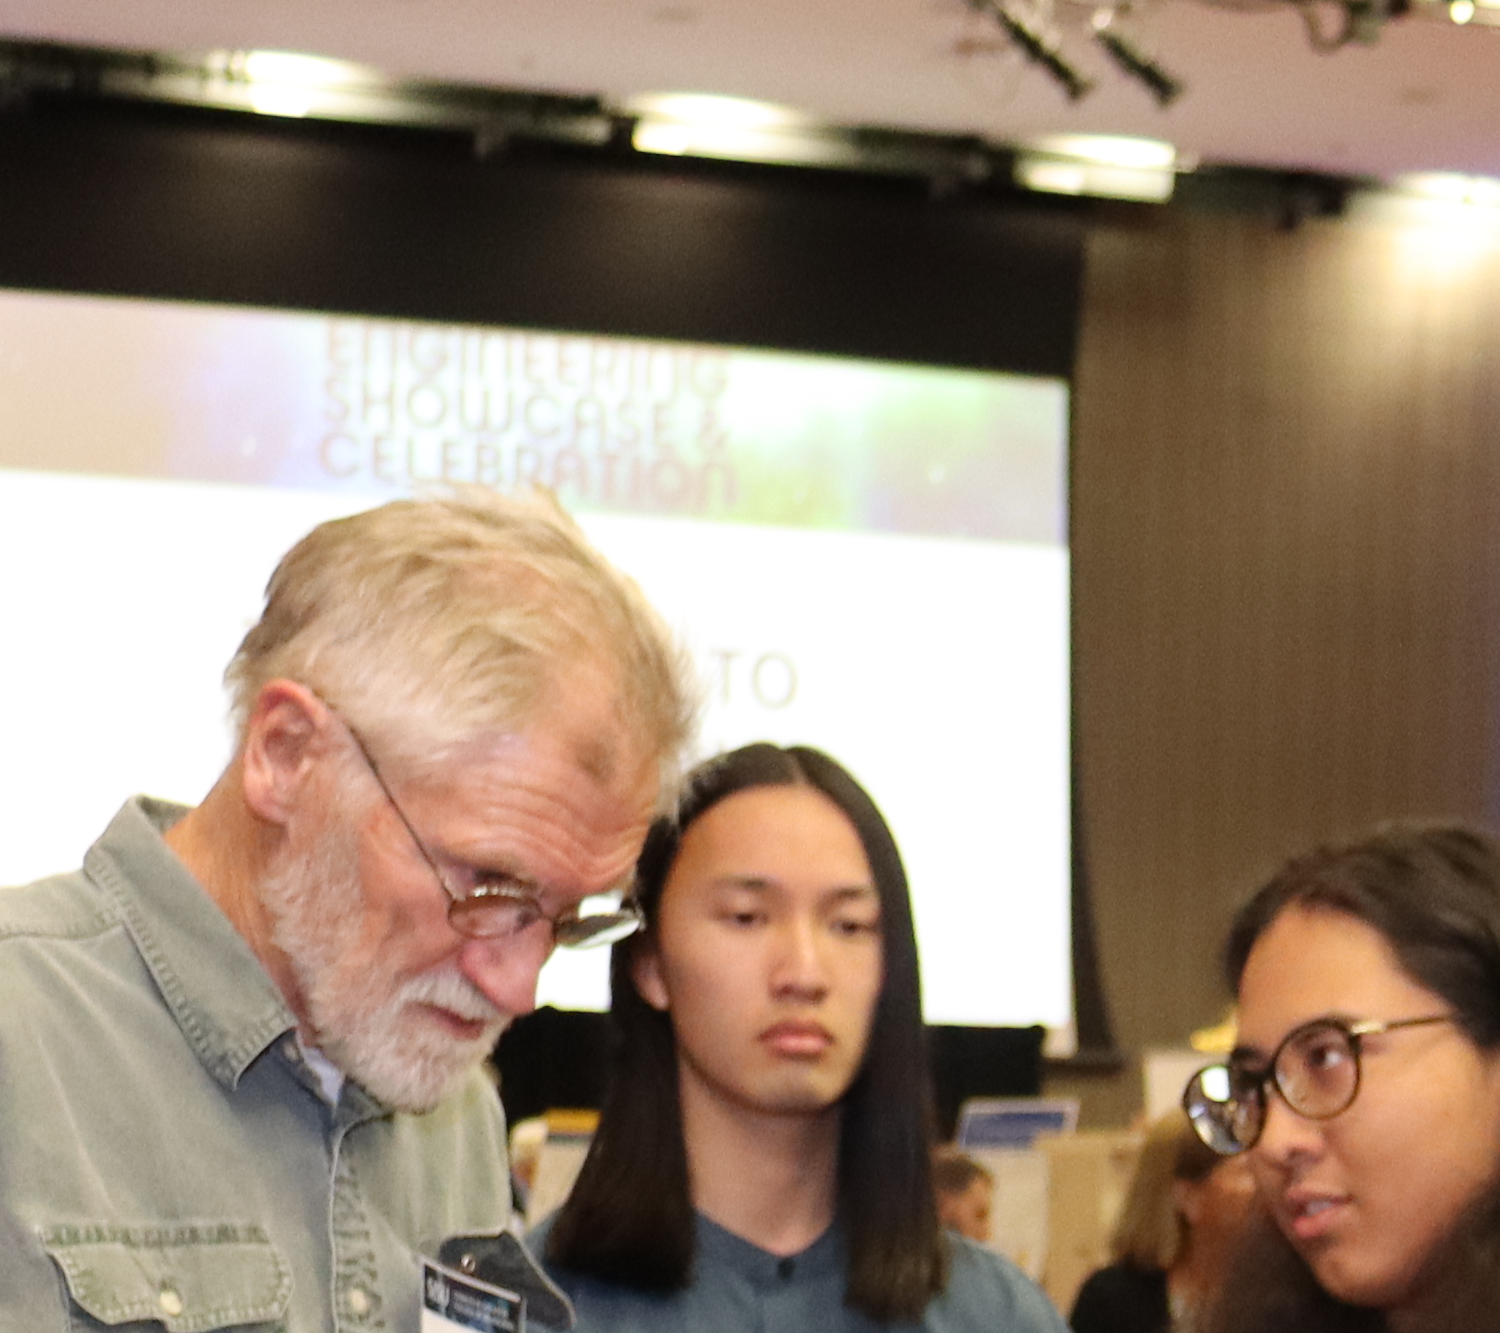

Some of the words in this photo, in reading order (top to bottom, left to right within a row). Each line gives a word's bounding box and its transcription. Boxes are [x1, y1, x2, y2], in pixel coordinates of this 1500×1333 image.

[322, 374, 676, 442] SHOWCASE
[697, 408, 731, 456] &
[319, 431, 738, 508] CELEBRATION
[714, 648, 800, 710] TO
